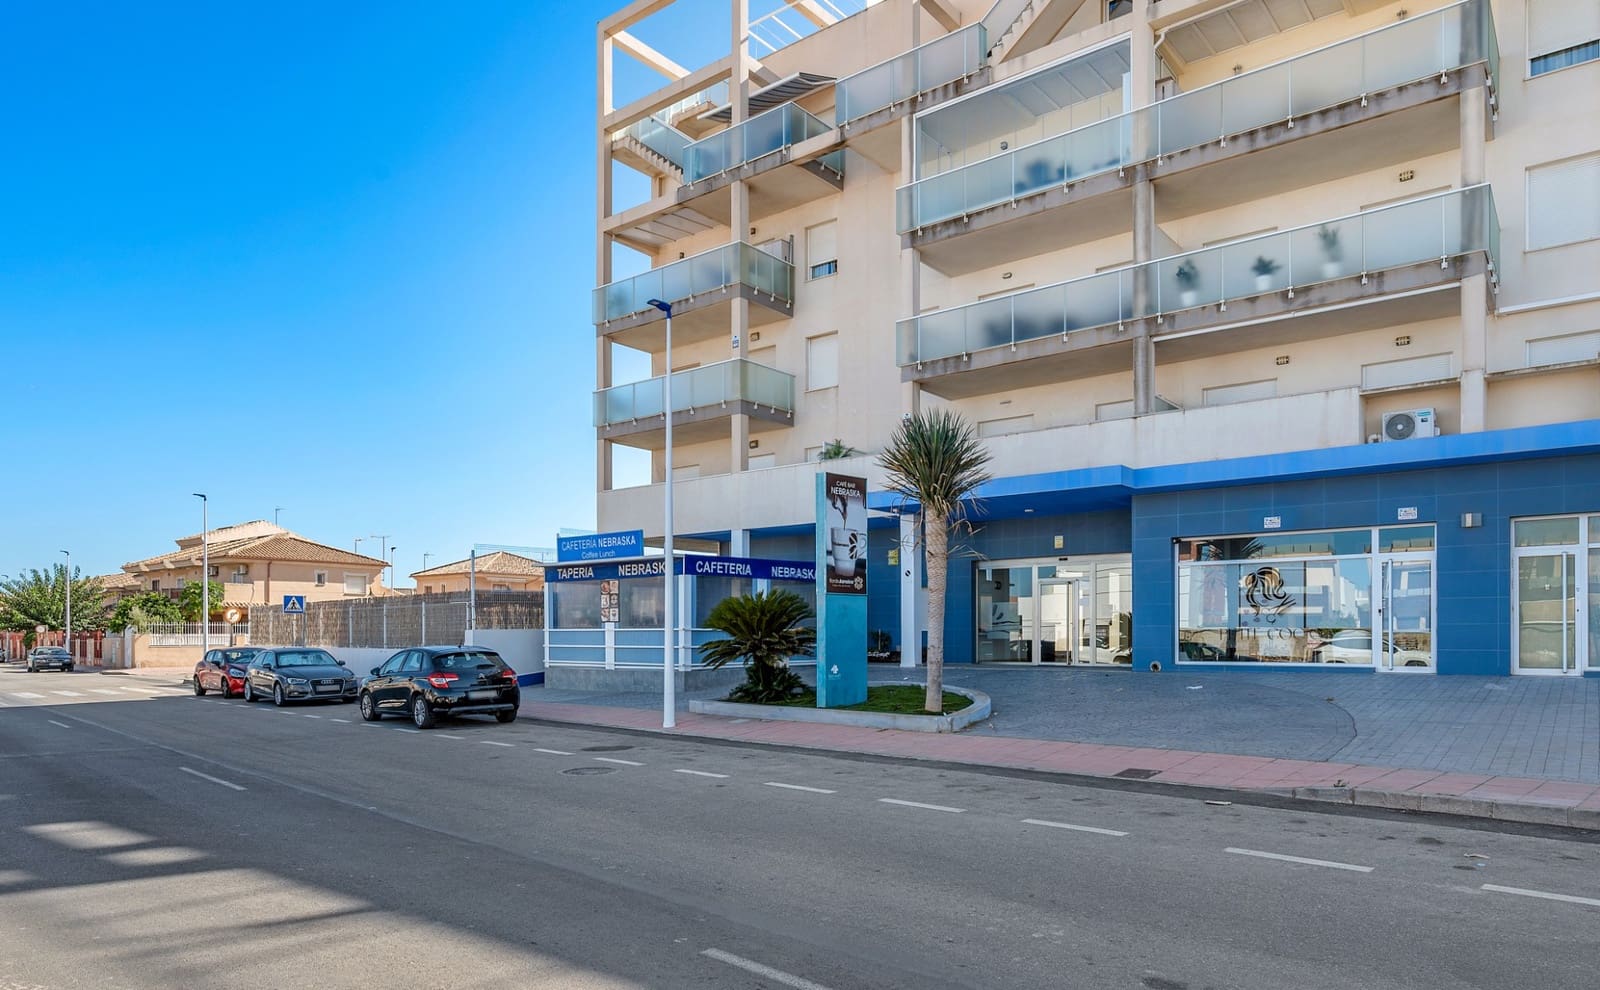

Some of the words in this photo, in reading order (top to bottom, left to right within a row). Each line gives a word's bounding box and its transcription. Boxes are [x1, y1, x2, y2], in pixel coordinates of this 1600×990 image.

[831, 486, 861, 497] NEBRASKA
[598, 535, 636, 548] NEBRASKA
[581, 551, 599, 560] Coffee
[600, 550, 616, 558] Lunch
[557, 566, 595, 580] TAPERIA
[618, 562, 666, 577] NEBRASK
[695, 560, 752, 576] CAFETERIA
[771, 566, 816, 580] NEBRASK
